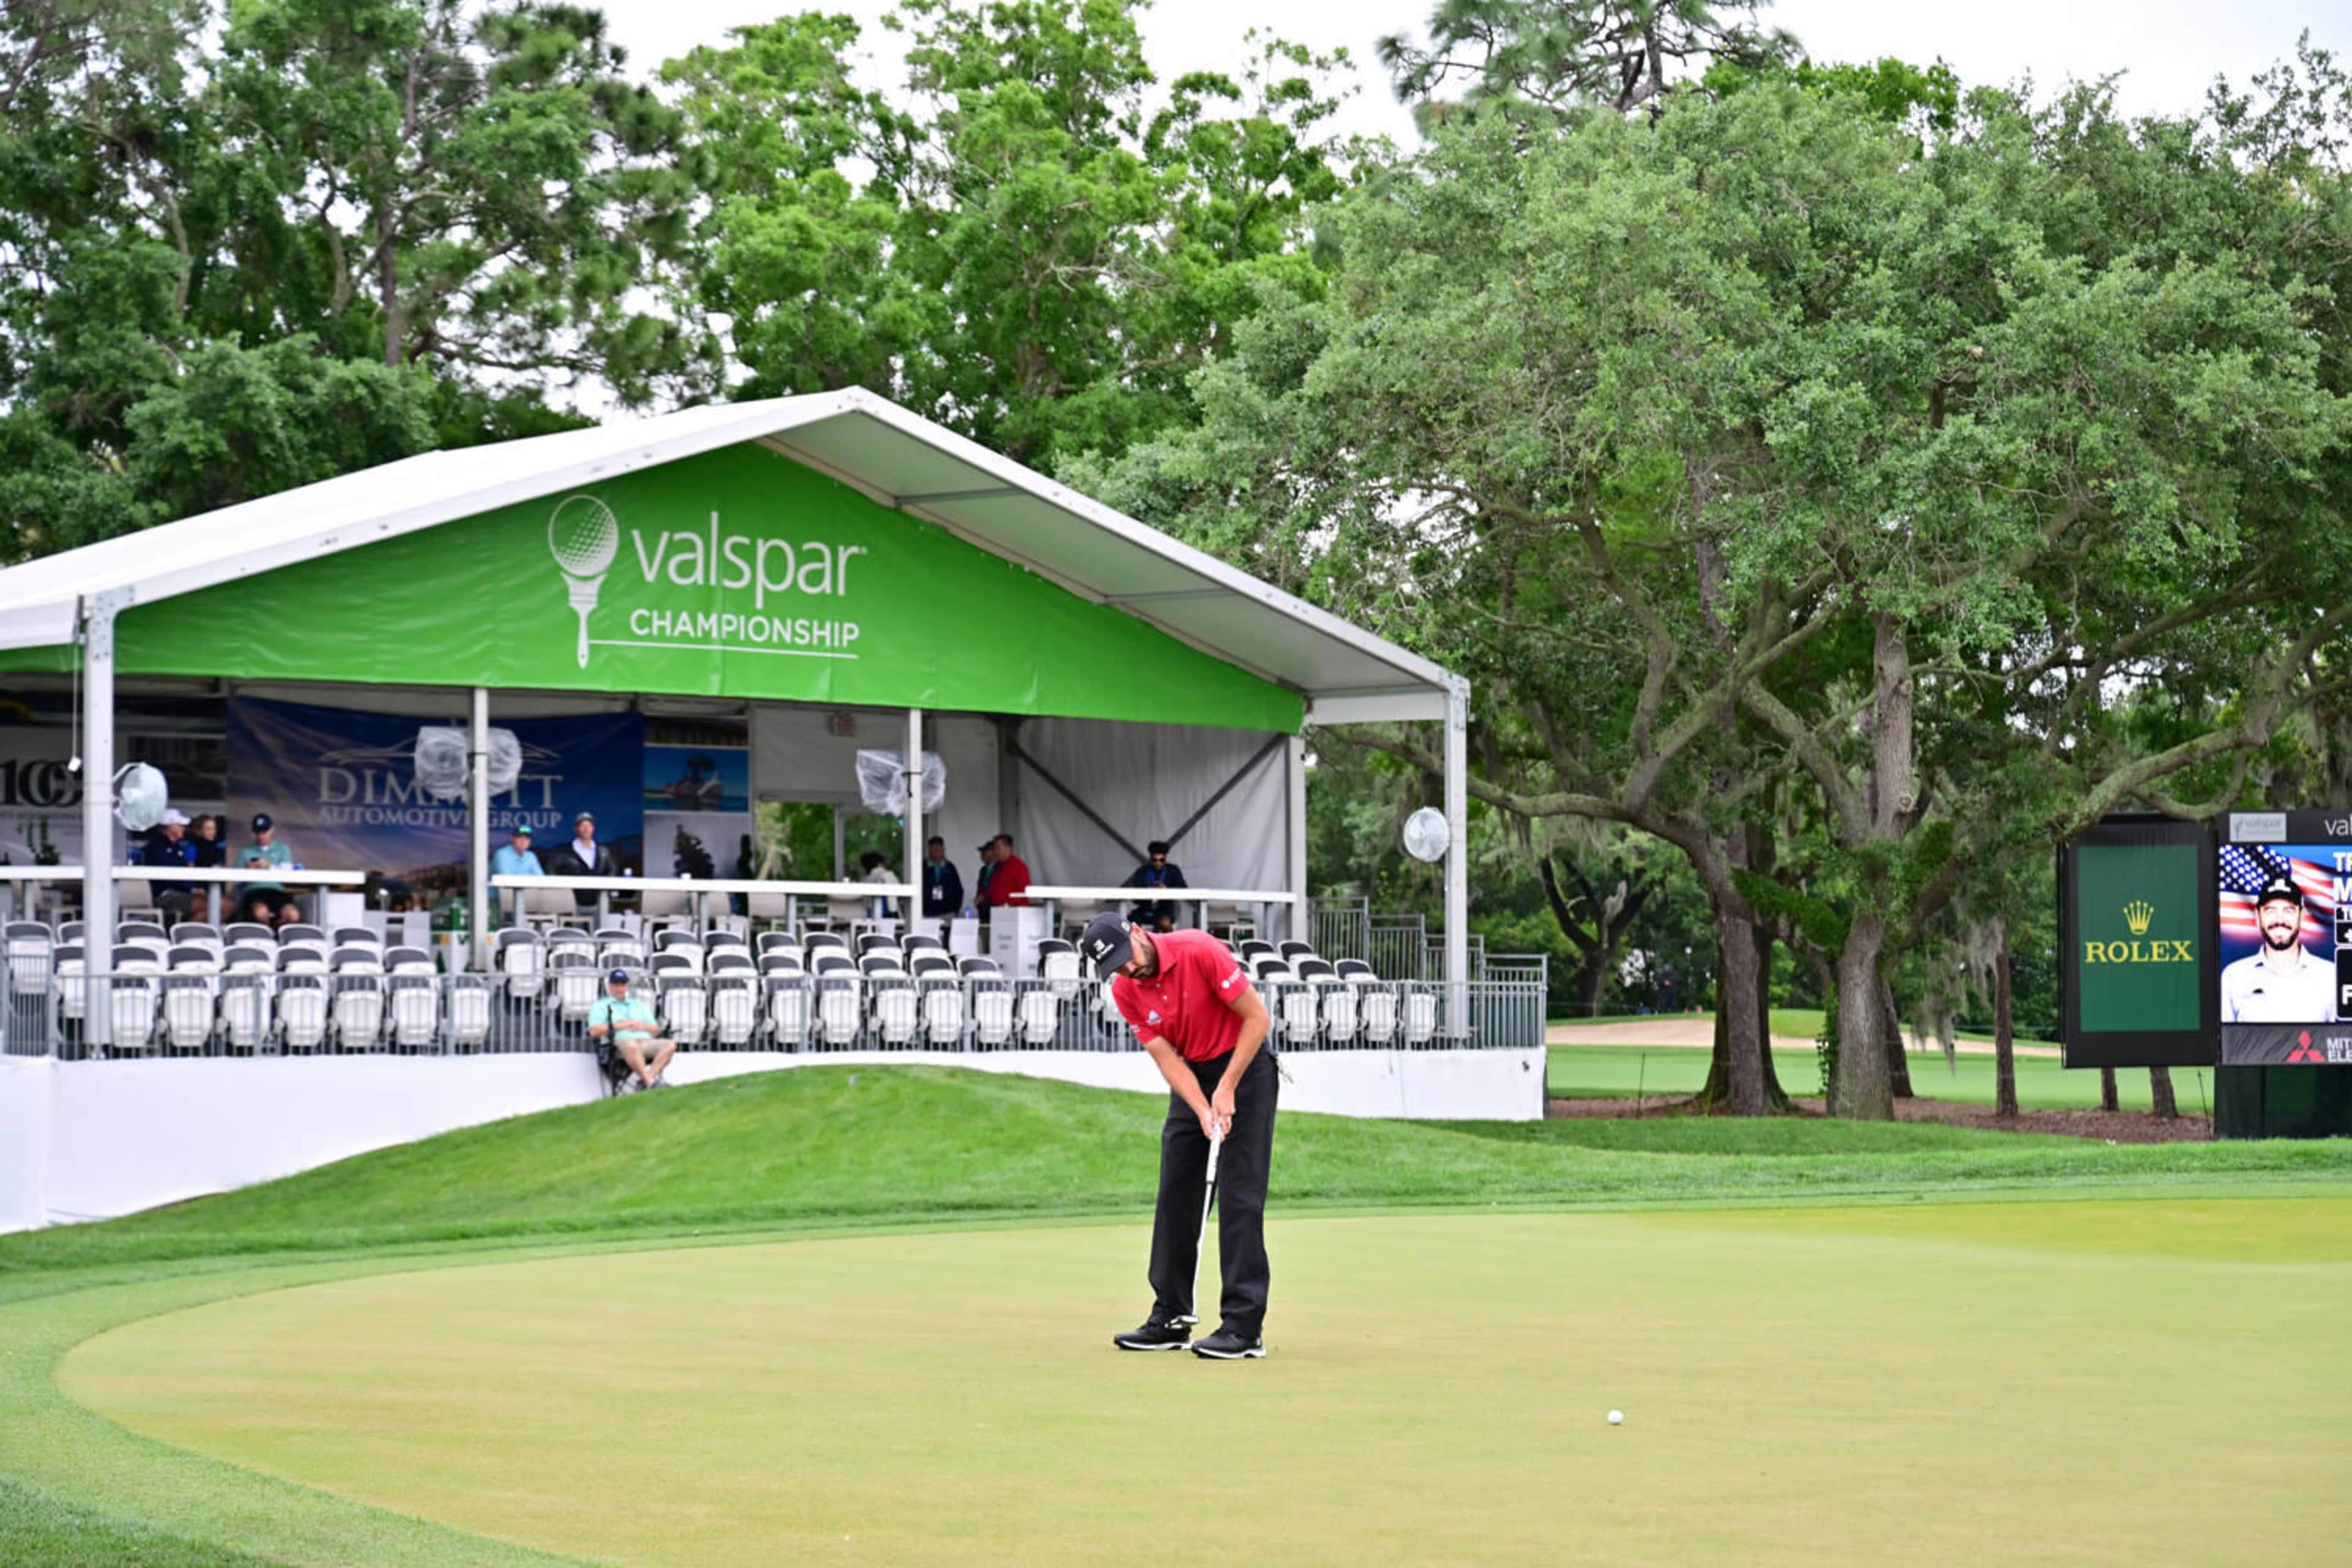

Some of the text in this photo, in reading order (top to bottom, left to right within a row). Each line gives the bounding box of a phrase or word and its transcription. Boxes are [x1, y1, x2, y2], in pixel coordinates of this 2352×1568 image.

[631, 511, 860, 609] valspar
[630, 608, 860, 647] CHAMPIONSHIP
[316, 767, 563, 809] DIMTT
[2085, 941, 2193, 963] ROLEX
